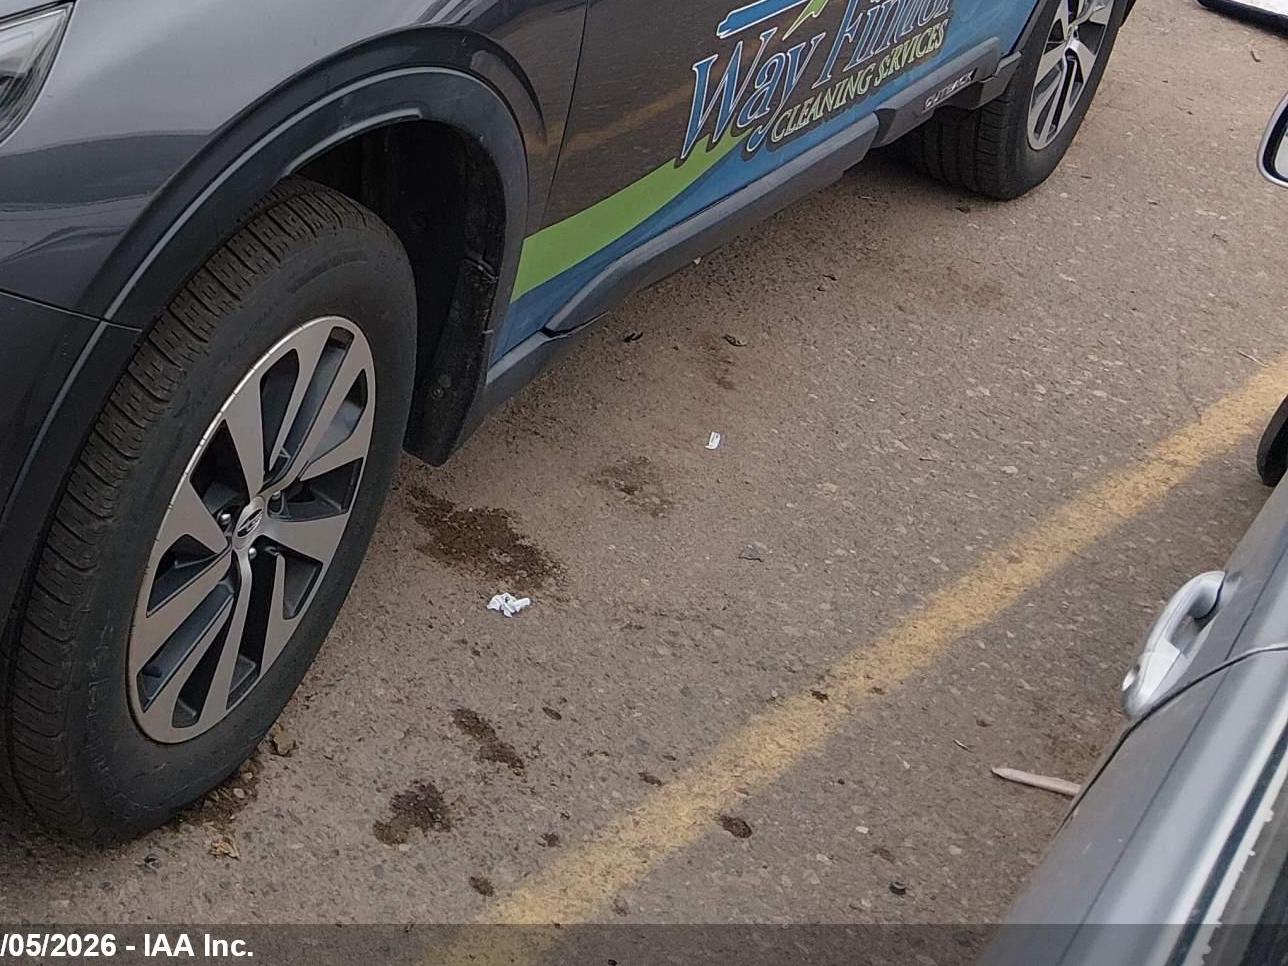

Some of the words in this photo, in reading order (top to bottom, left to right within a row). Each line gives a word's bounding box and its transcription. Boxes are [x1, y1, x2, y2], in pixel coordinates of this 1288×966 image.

[680, 28, 826, 160] Way
[771, 63, 877, 143] CLEANING
[873, 19, 949, 87] SERVICES
